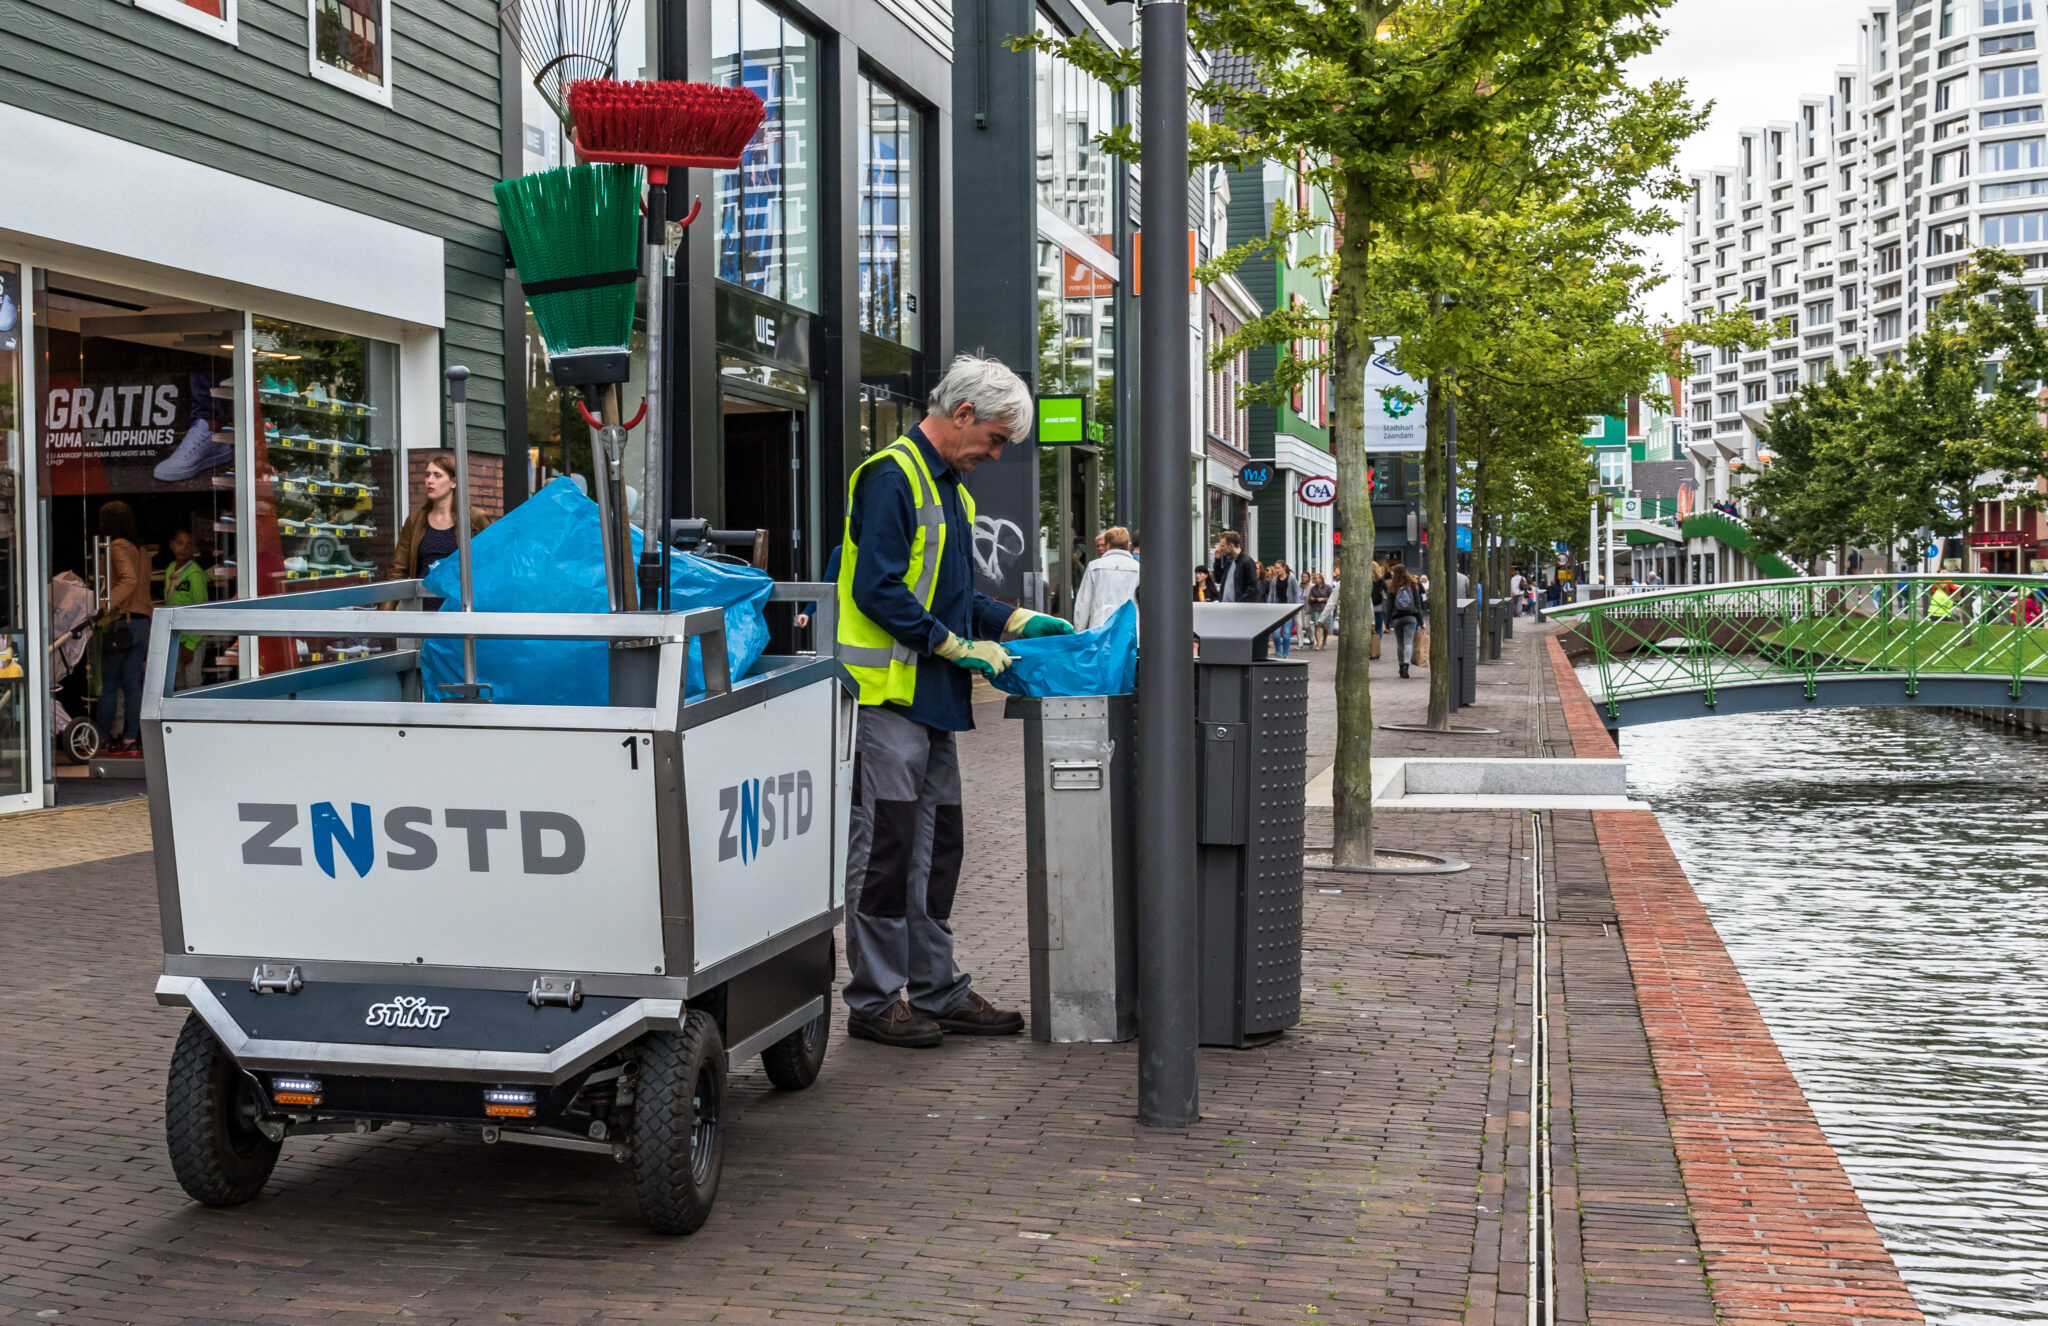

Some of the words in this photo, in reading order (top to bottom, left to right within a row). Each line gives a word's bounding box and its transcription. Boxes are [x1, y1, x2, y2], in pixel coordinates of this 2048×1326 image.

[755, 314, 776, 347] WE
[45, 384, 179, 430] GRATIS
[46, 432, 82, 448] PUMA
[86, 429, 175, 447] ADPHONES
[1383, 424, 1414, 432] Stadshart
[1305, 484, 1332, 498] C&A
[621, 736, 639, 770] 1
[718, 769, 813, 867] ZNSTD
[237, 801, 586, 880] ZNSTD
